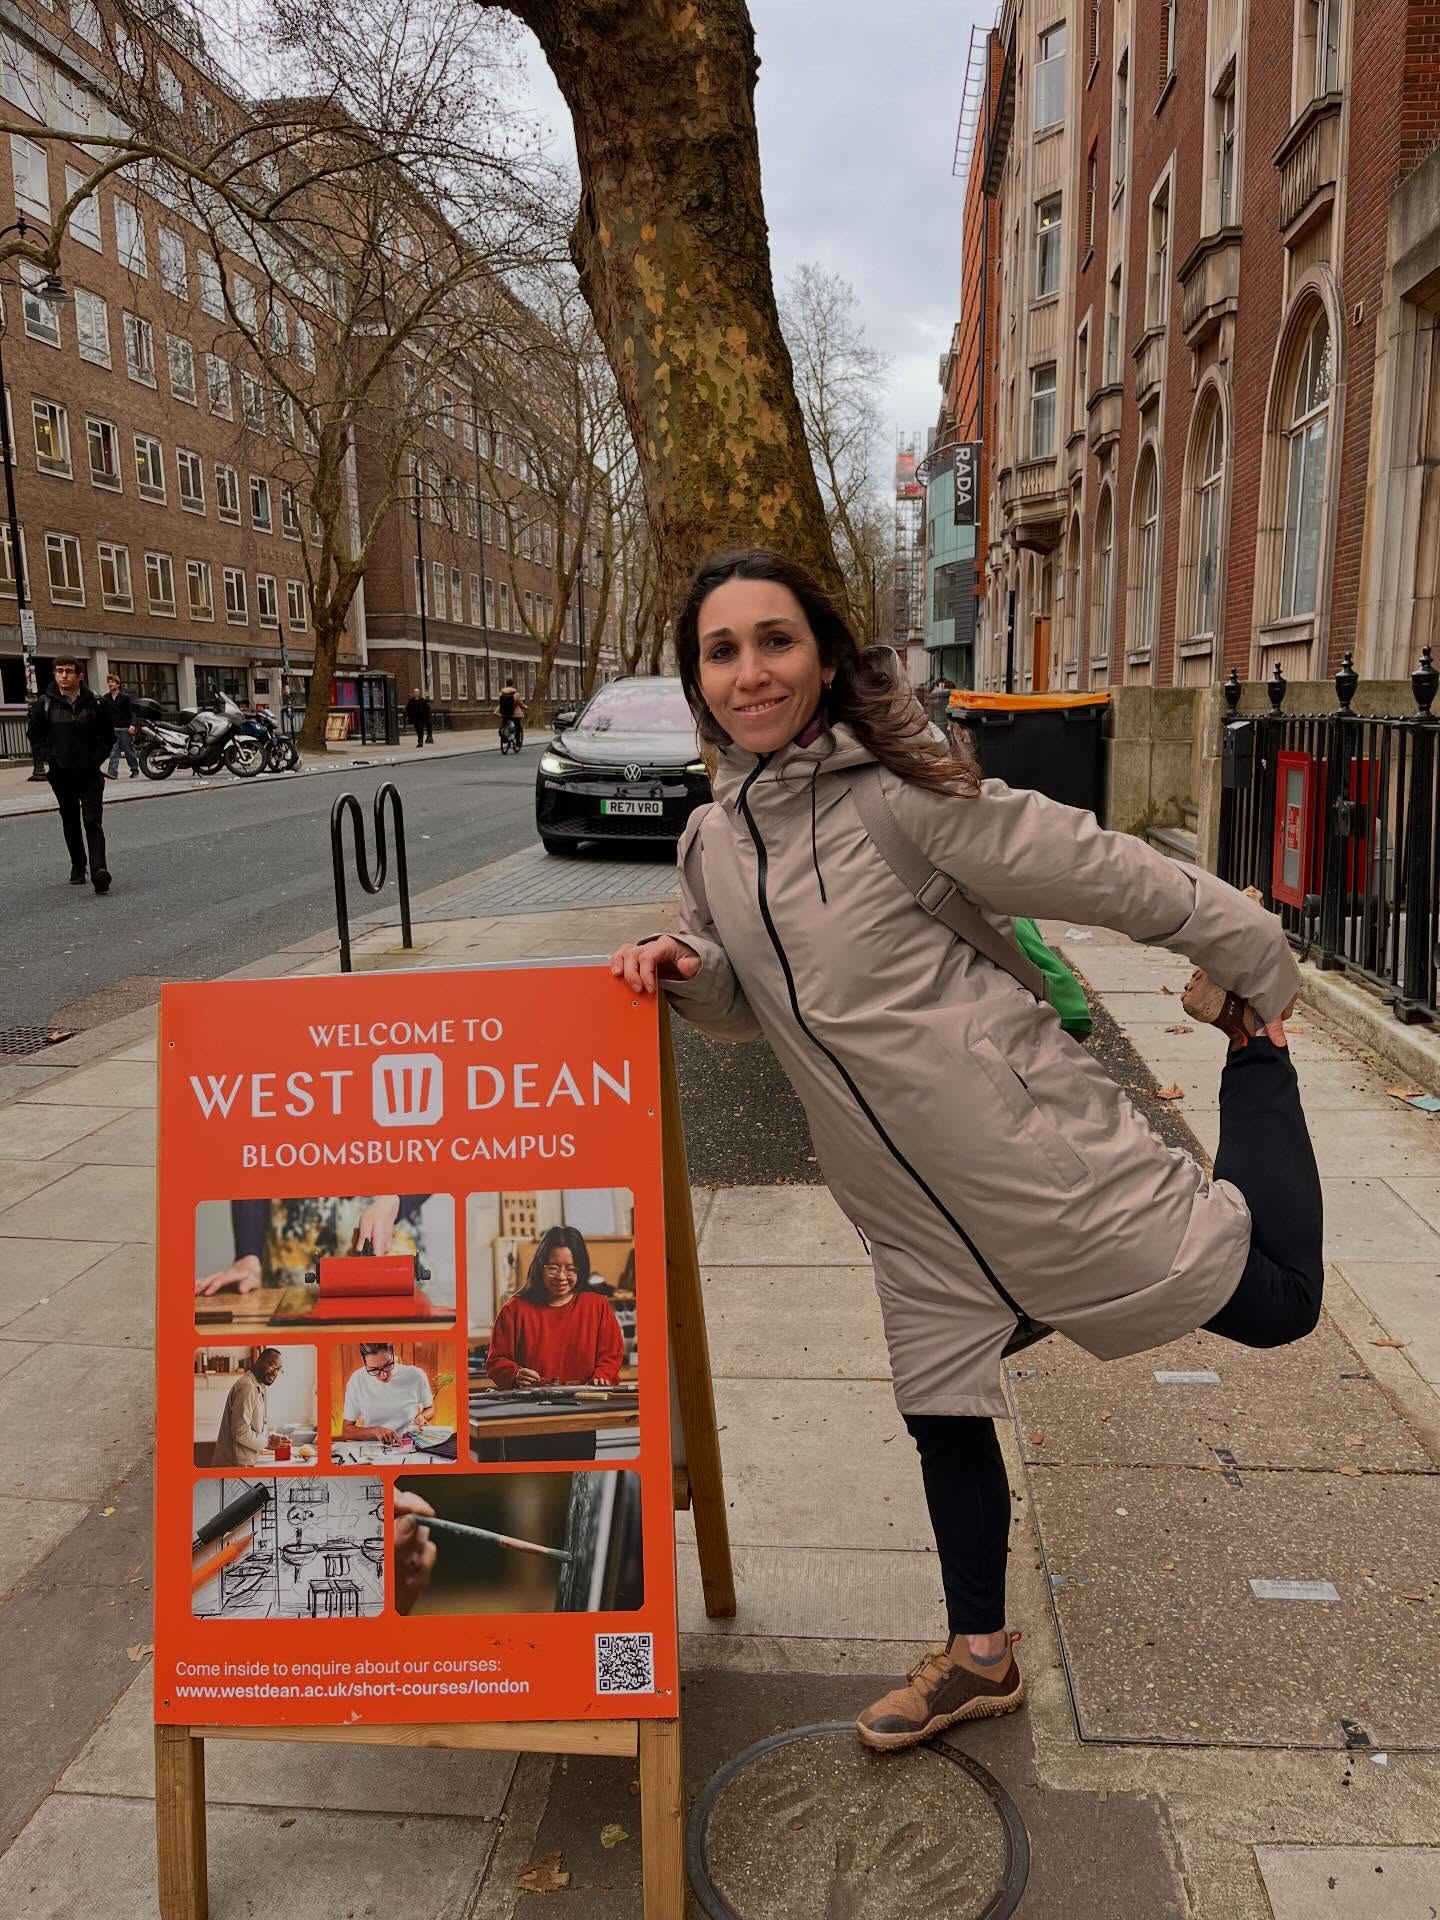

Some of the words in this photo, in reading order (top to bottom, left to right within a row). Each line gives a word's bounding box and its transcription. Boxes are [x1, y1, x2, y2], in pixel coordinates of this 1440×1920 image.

[956, 447, 971, 505] RADA
[308, 1020, 455, 1047] WELCOME
[462, 1017, 503, 1042] TO
[189, 1070, 354, 1120] WEST
[467, 1059, 631, 1111] DEAN
[242, 1138, 444, 1168] BLOOMSBURY
[450, 1133, 576, 1161] CAMPUS
[175, 1661, 220, 1677] Come
[224, 1661, 270, 1676] inside
[273, 1662, 289, 1676] to
[291, 1660, 351, 1679] enquire
[354, 1660, 400, 1675] about
[403, 1661, 430, 1673] our
[433, 1659, 501, 1673] courses:
[175, 1678, 530, 1699] www.westdean.ac.uk/short-courses/london
